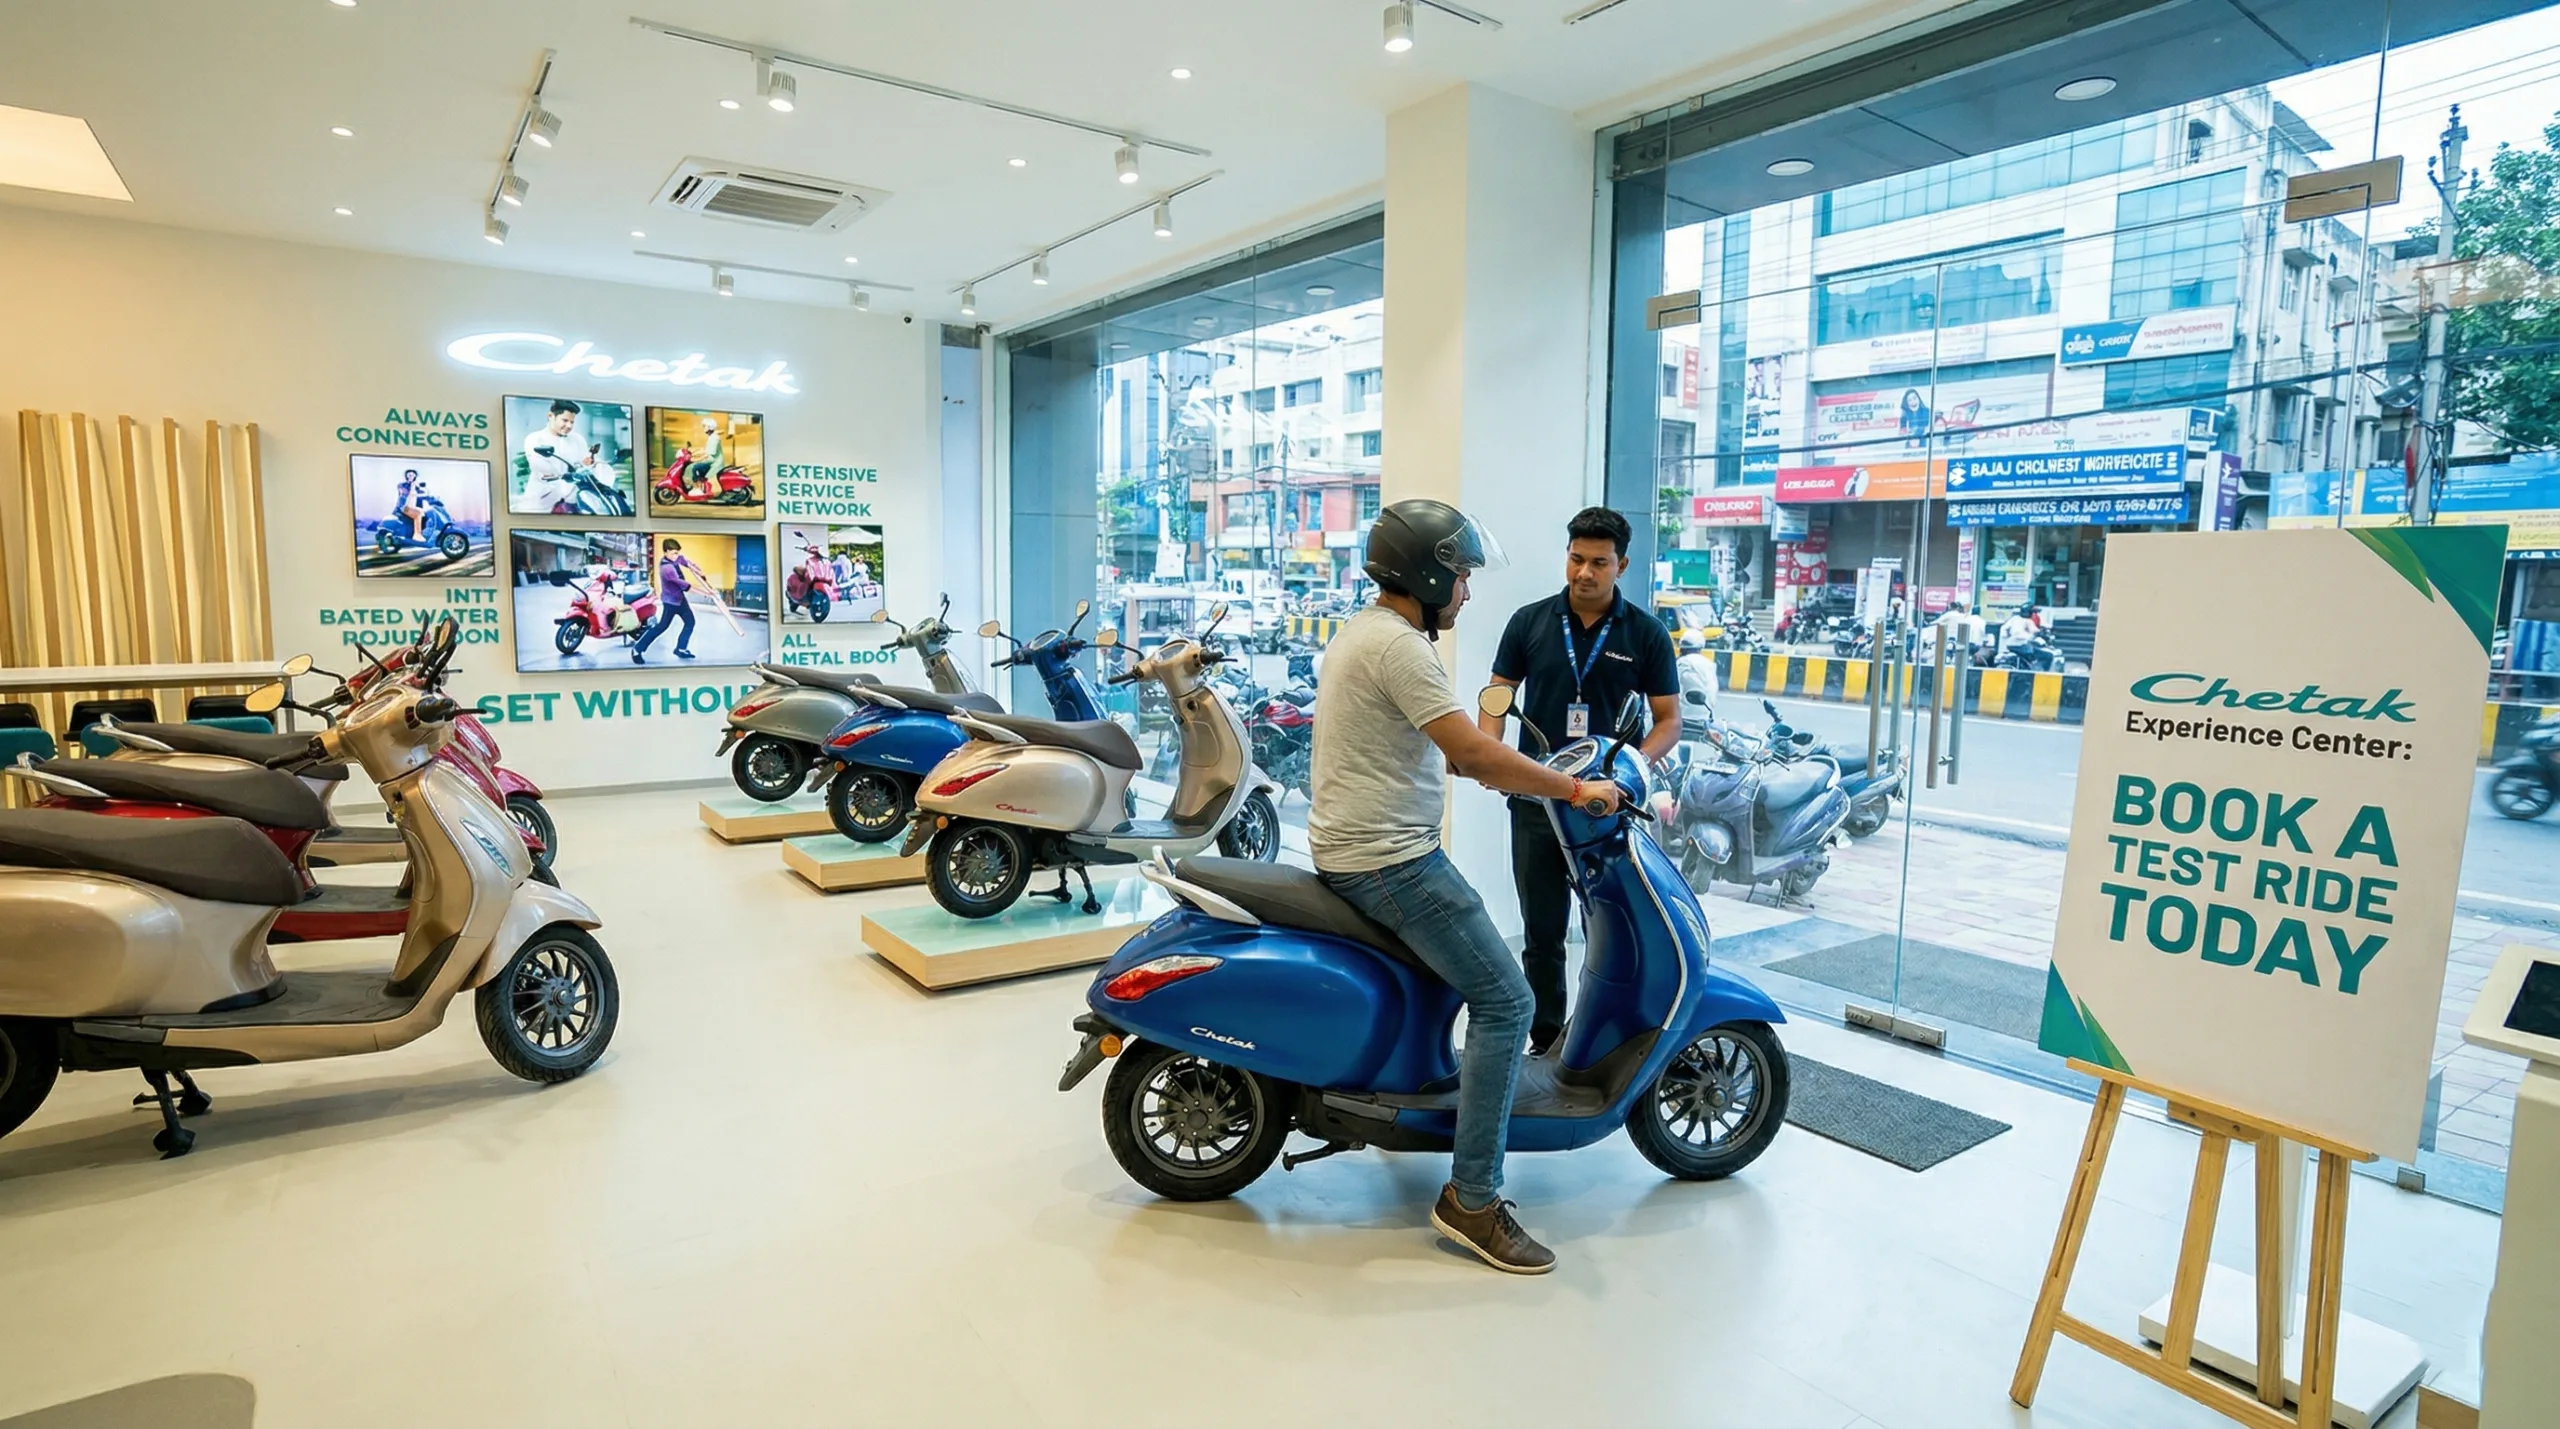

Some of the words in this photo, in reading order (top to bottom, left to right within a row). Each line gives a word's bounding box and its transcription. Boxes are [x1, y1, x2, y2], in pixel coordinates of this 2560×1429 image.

[446, 331, 801, 396] Chetak
[385, 407, 488, 429] ALWAYS
[336, 426, 490, 450] CONNECTED
[776, 464, 878, 483] EXTENSIVE
[1970, 460, 2012, 477] BAJAJ
[777, 482, 855, 499] SERVICE
[777, 500, 873, 517] NETWORK
[446, 588, 498, 604] INTT
[320, 609, 404, 625] BATED
[411, 608, 499, 624] WATER
[781, 634, 817, 648] ALL
[782, 651, 844, 665] METAL
[476, 692, 561, 724] SET
[2130, 673, 2416, 722] Chetak
[2126, 710, 2284, 748] Experience
[2291, 725, 2413, 760] Center:
[2112, 774, 2319, 854] BOOK
[2334, 805, 2399, 867] A
[2107, 834, 2242, 893] TEST
[2253, 859, 2399, 924] RIDE
[2100, 882, 2390, 996] TODAY
[1190, 1026, 1256, 1051] Chetak
